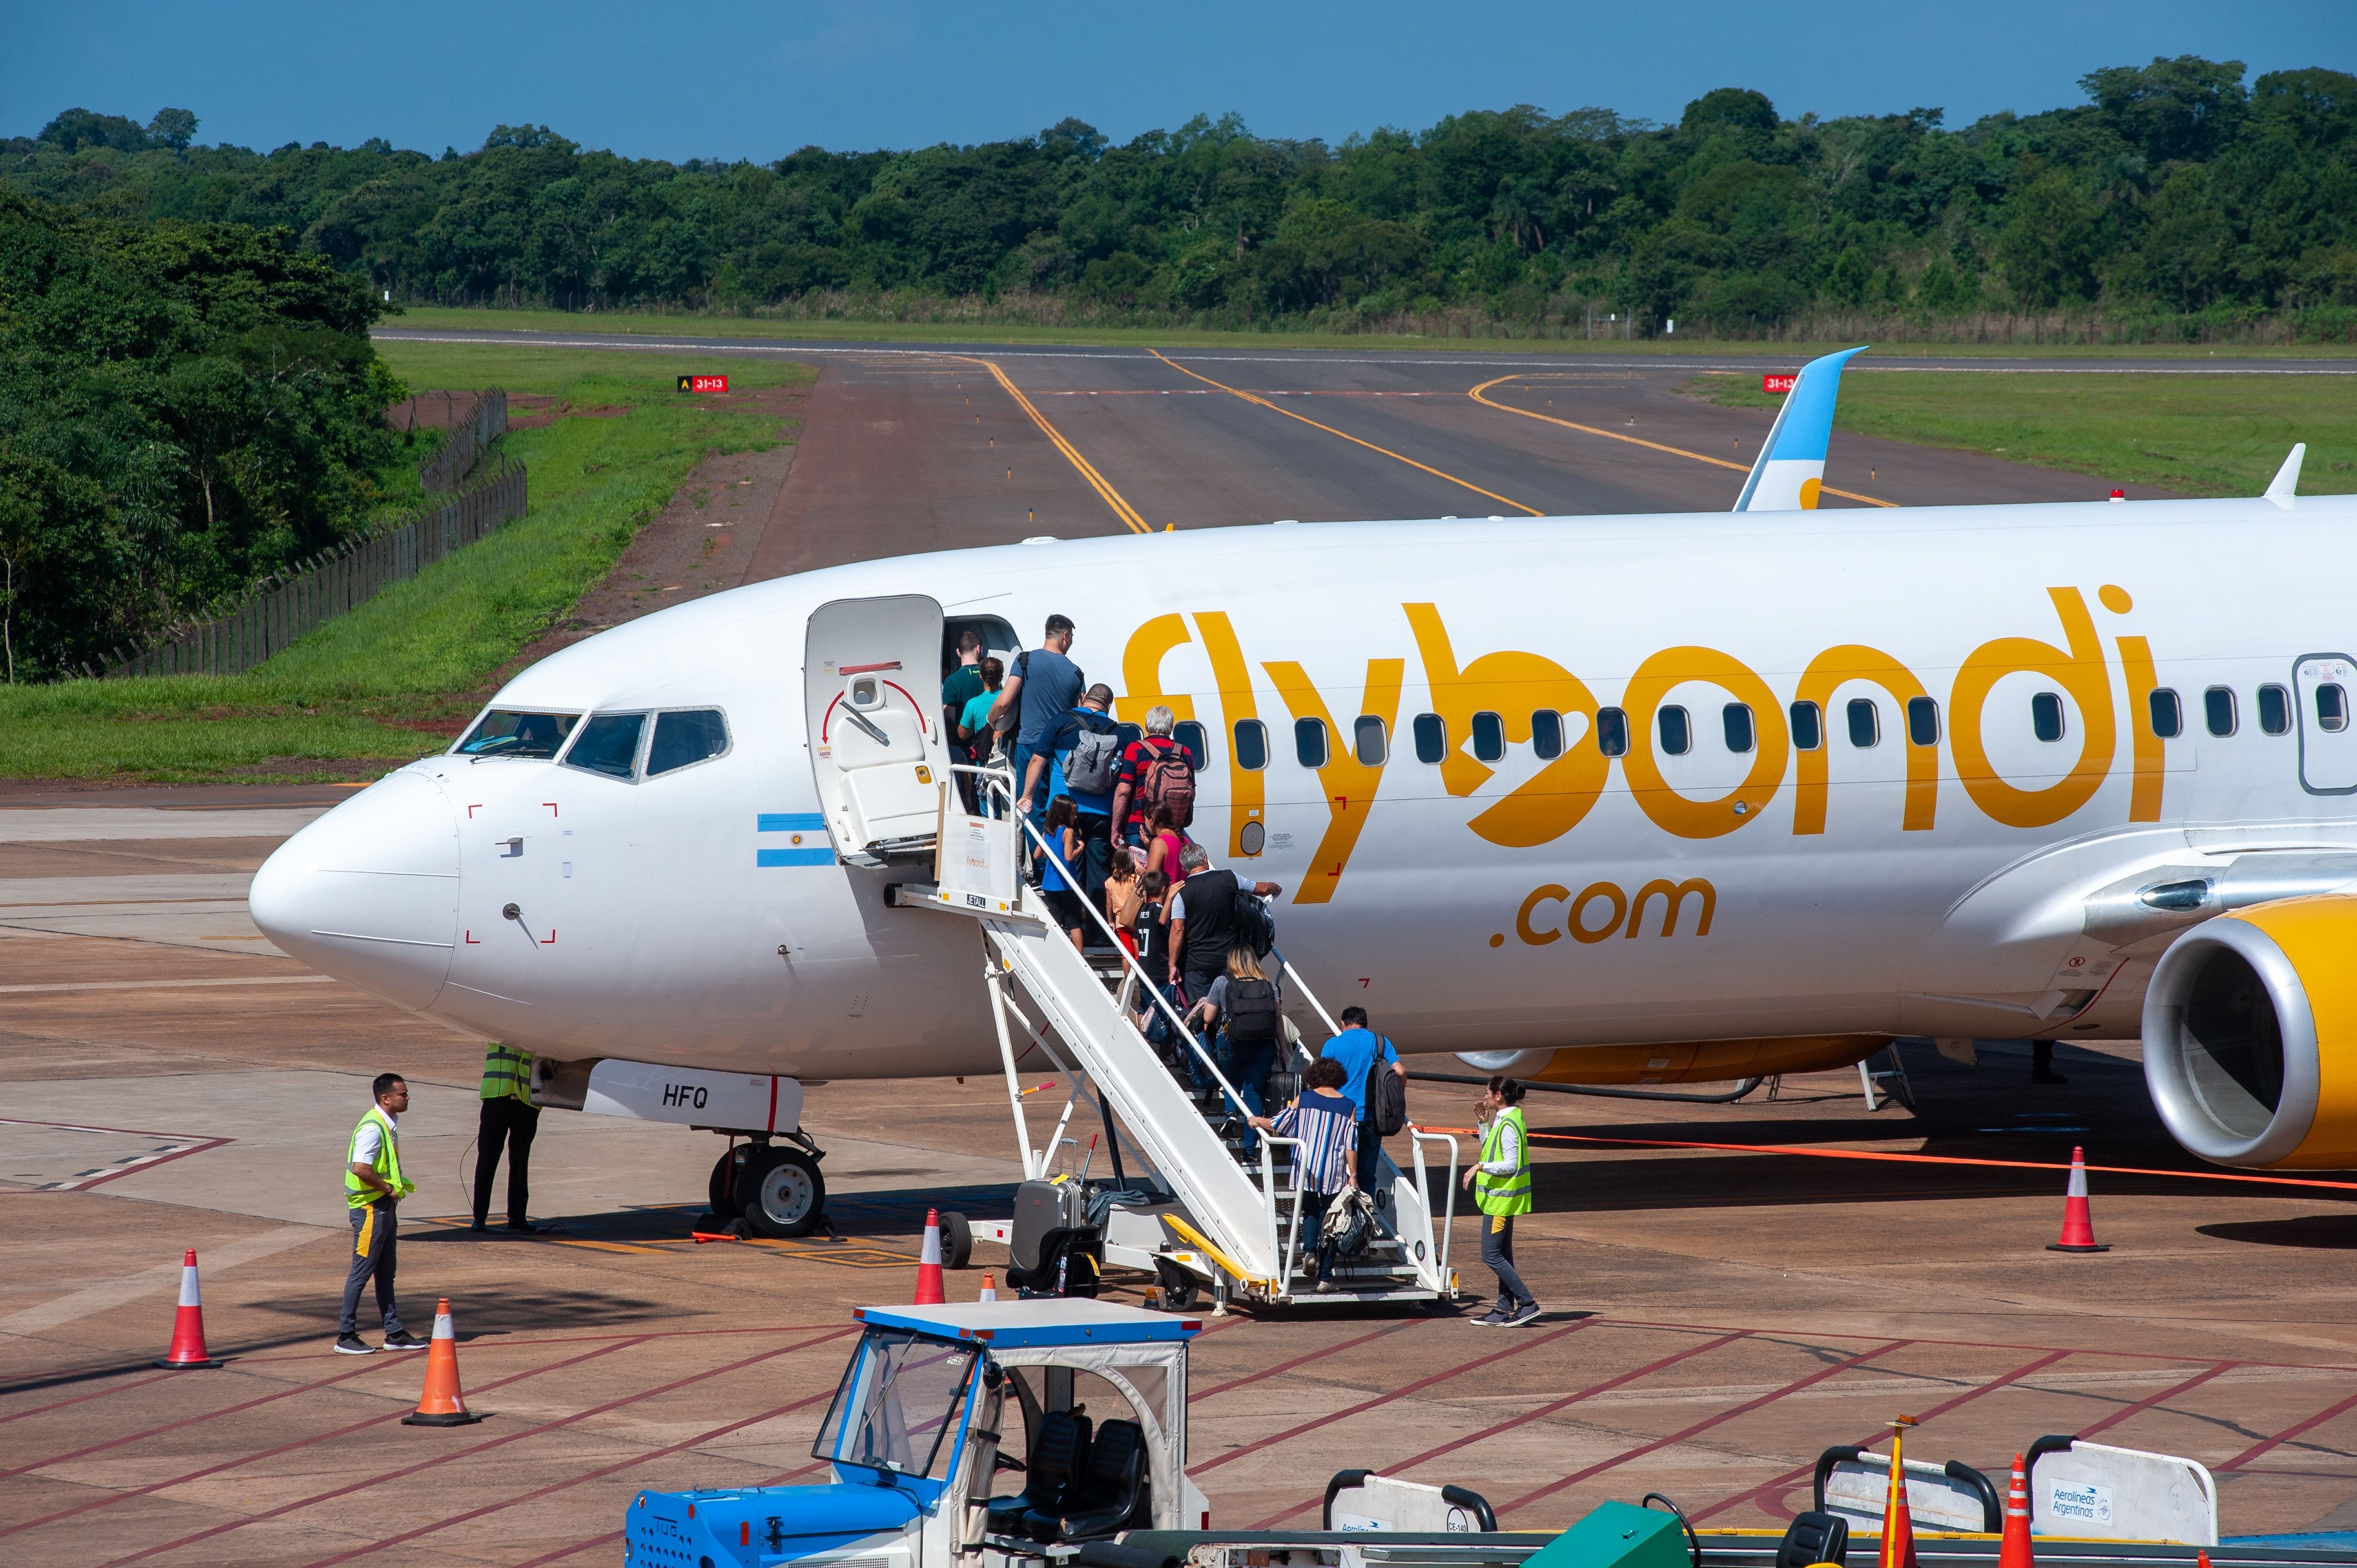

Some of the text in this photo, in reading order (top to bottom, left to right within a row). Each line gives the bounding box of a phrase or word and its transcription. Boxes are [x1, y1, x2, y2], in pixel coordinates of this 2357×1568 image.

[681, 379, 723, 389] A 31-13
[1768, 379, 1794, 388] 31-13
[1114, 584, 2165, 904] flybondi
[967, 895, 985, 908] JETALL
[1489, 878, 1716, 948] .com
[662, 1084, 708, 1109] HFQ
[2054, 1489, 2095, 1505] Aerolíneas
[2053, 1501, 2094, 1518] Argentinas
[652, 1516, 677, 1538] TUG
[1449, 1522, 1466, 1533] CE-140
